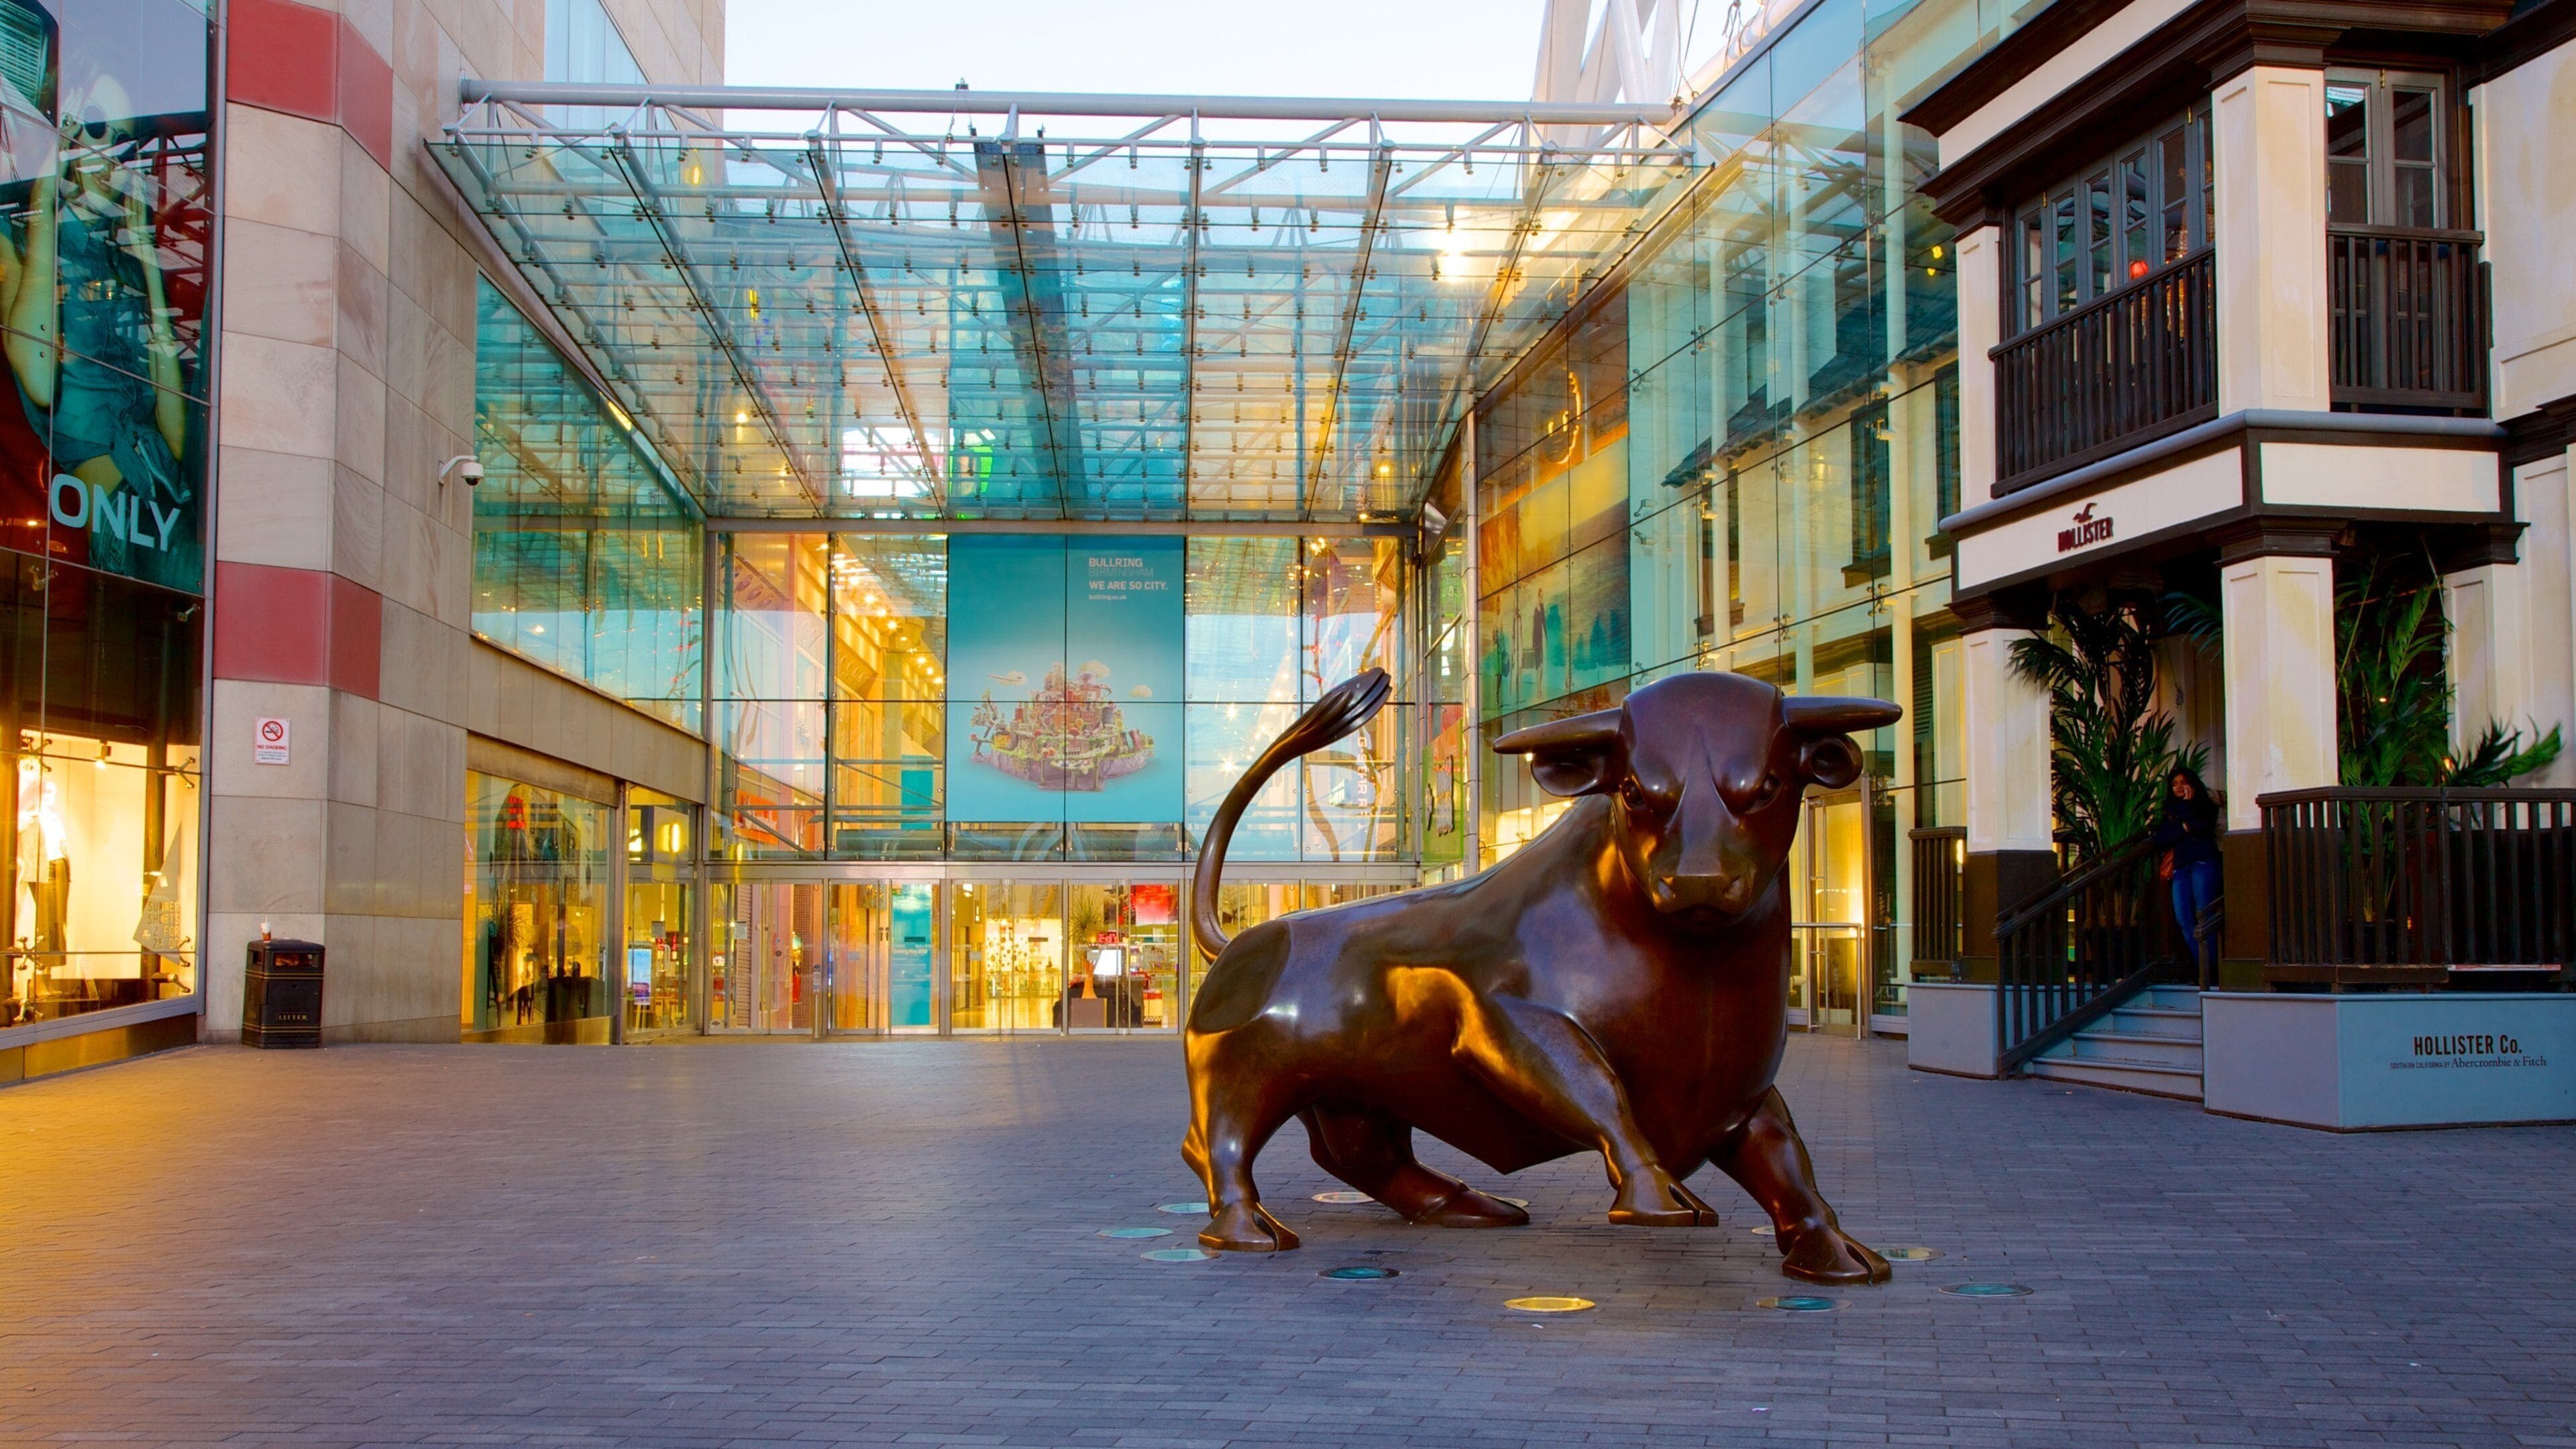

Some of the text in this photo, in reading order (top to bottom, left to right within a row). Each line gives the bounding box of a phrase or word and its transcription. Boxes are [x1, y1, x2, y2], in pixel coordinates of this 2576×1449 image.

[51, 474, 181, 553] ONLY
[2057, 517, 2114, 553] HOLLISTER
[1089, 557, 1143, 568] BULLRING
[1089, 568, 1154, 577] BIRMINGHAM
[1089, 581, 1169, 590] WE ARE SO CITY.
[148, 901, 180, 912] SUMMER
[148, 913, 180, 924] SHORTS
[153, 926, 180, 937] 2 FOR
[2414, 1034, 2522, 1056] HOLLISTER Co.
[2451, 1057, 2512, 1068] Abercrombie
[2513, 1059, 2520, 1067] &
[2522, 1056, 2547, 1067] Fitch
